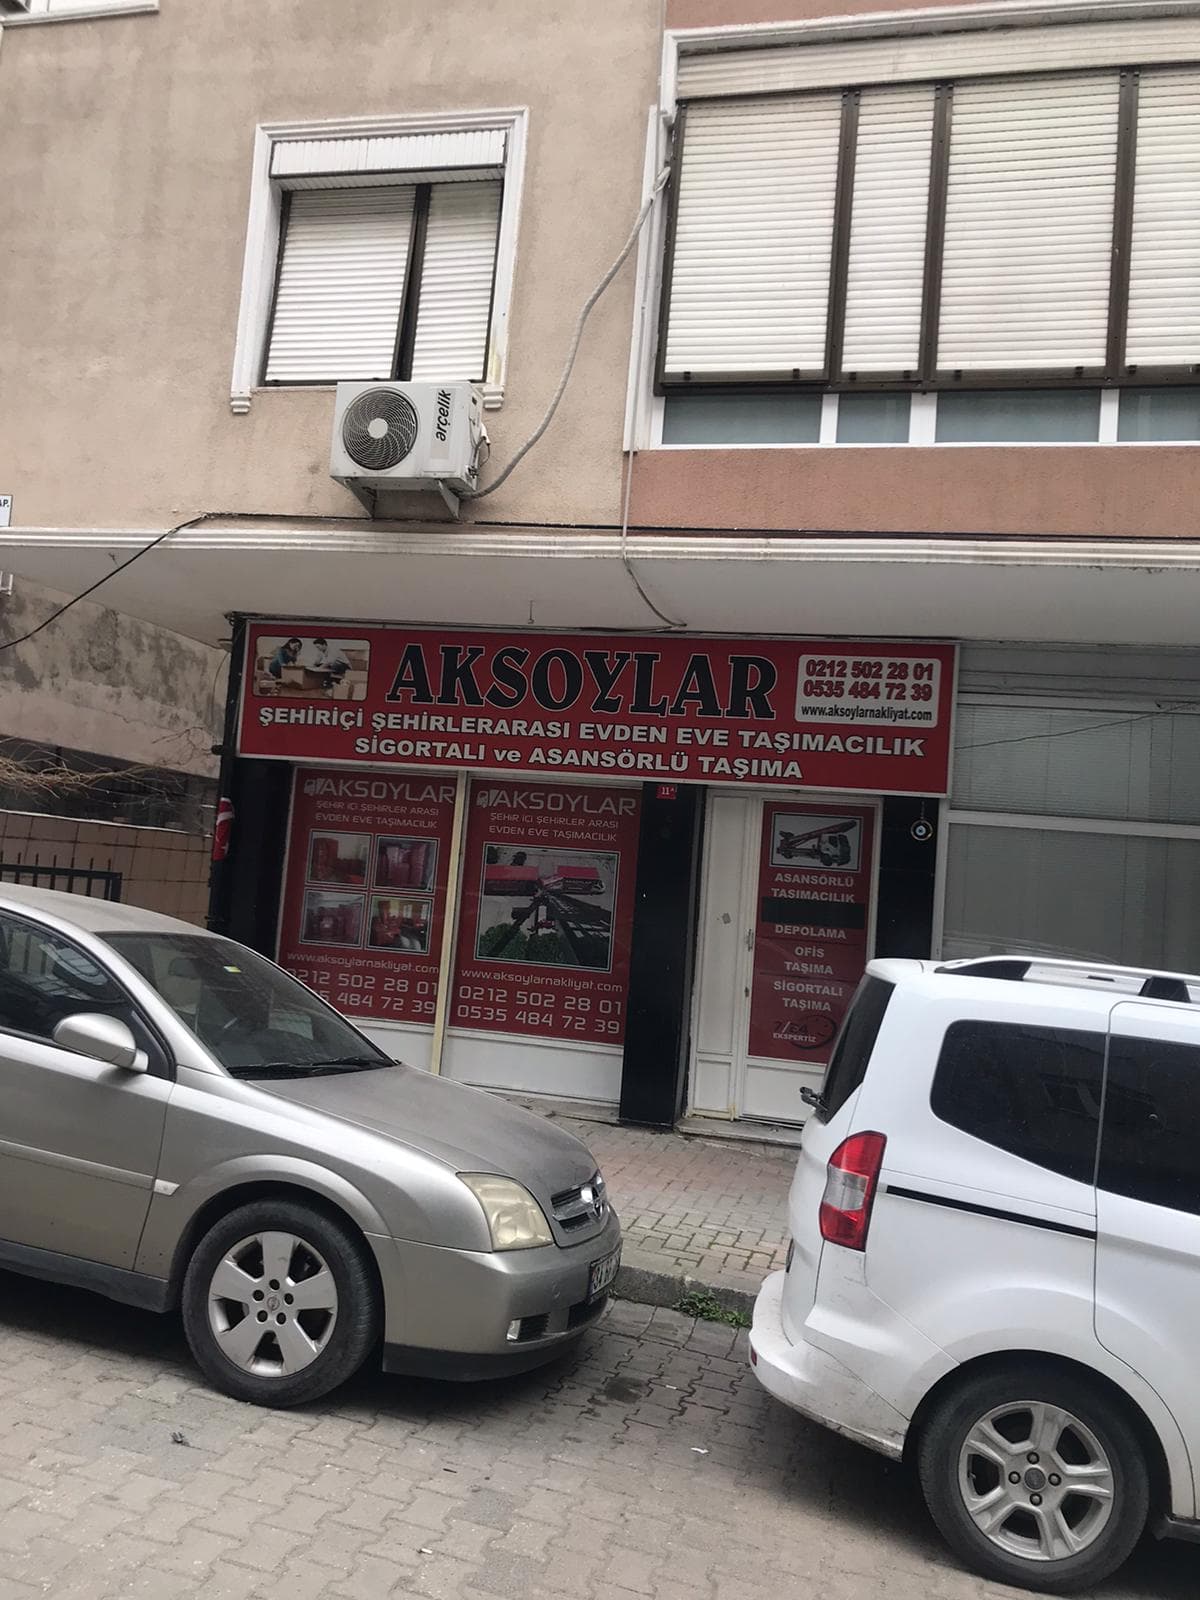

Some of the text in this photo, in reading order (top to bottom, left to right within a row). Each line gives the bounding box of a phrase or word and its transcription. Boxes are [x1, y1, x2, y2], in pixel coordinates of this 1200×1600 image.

[436, 390, 451, 442] arçelik
[385, 643, 778, 720] AKSOYLAR
[806, 659, 934, 681] 0212 502 28 01
[803, 680, 933, 701] 0535 484 72 39
[801, 704, 932, 722] www.aksoylarnakliyat.com
[259, 706, 926, 757] ŞEHİRİÇİ ŞEHİRLERARASI EVDEN EVE TAŞIMACILIK
[355, 735, 803, 779] SİGORTALI ve ASANSÖRLÜ TAŞIMA
[319, 778, 455, 804] AKSOYLAR
[492, 790, 637, 816] AKSOYLAR
[314, 812, 350, 823] EVDEN
[352, 815, 373, 825] EVE
[588, 819, 618, 829] ARASI
[489, 825, 525, 836] EVDEN
[528, 828, 550, 838] EVE
[775, 924, 847, 939] DEPOLAMA
[287, 951, 439, 974] www.aksoylarnakliyat.com
[794, 946, 825, 958] OFİS
[784, 961, 833, 975] TAŞIMA
[338, 973, 376, 990] 502
[384, 977, 409, 993] 28
[416, 981, 438, 996] 01
[461, 968, 623, 993] www.aksoylarnakliyat.com
[773, 980, 843, 996] SİGORTALI
[337, 992, 373, 1008] 484
[380, 996, 404, 1011] 72
[411, 1000, 436, 1015] 39
[459, 985, 622, 1016] 0212 502 28 01
[782, 998, 832, 1012] TAŞIMA
[457, 1004, 620, 1034] 0535 484 72 39
